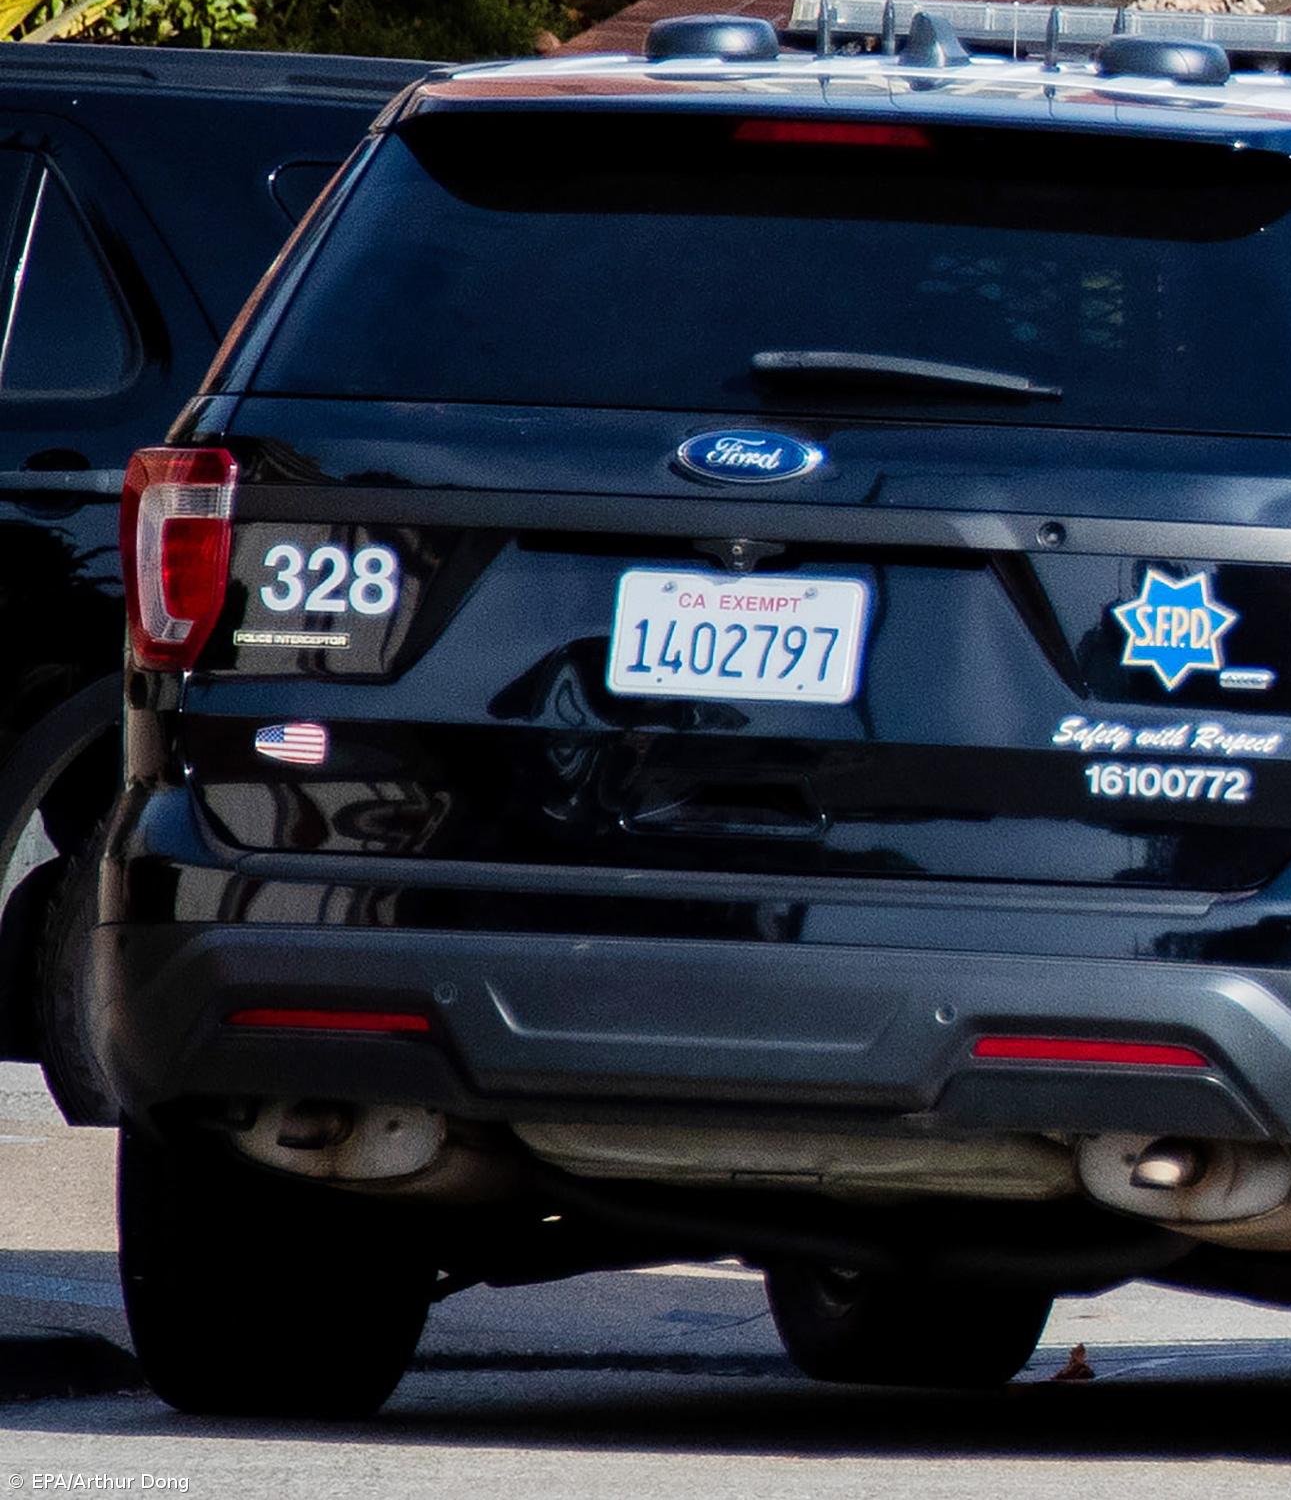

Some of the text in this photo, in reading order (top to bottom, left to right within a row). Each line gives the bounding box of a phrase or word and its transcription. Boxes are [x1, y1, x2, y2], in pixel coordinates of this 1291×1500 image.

[706, 437, 783, 470] Ford
[260, 544, 395, 615] 328
[678, 592, 802, 613] CA EXEMPT
[626, 618, 840, 682] 1402797
[1052, 715, 1283, 755] Safety with Respect
[1084, 764, 1248, 801] 16100772
